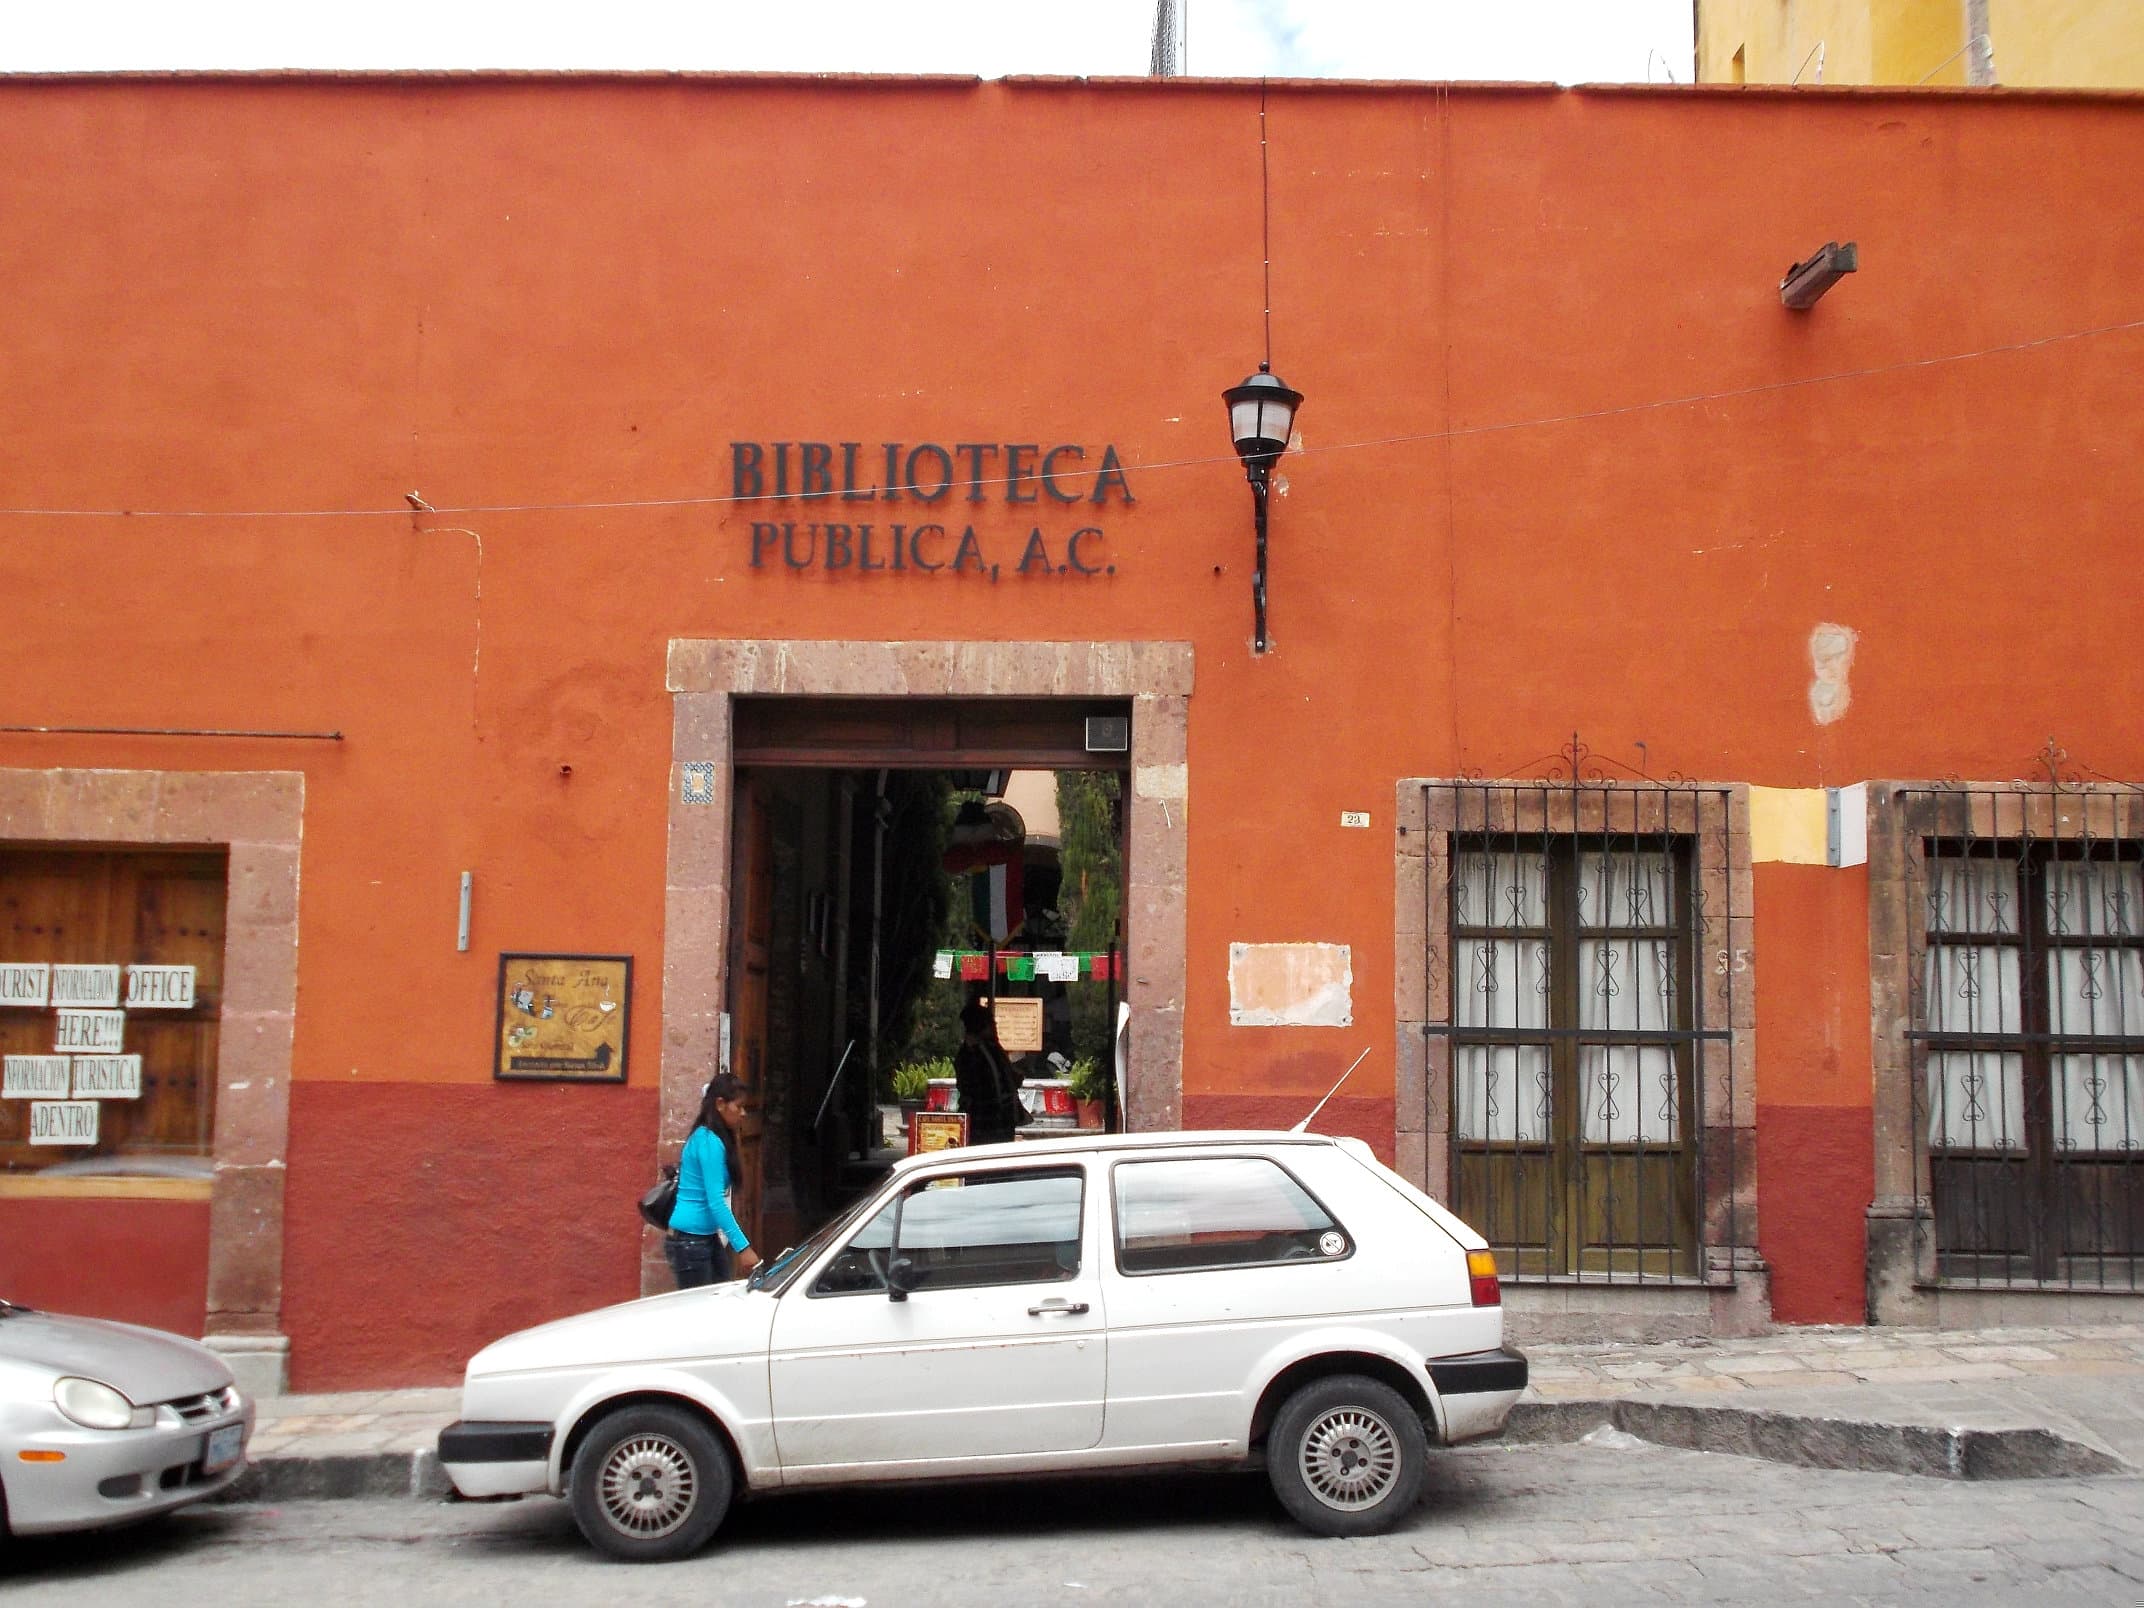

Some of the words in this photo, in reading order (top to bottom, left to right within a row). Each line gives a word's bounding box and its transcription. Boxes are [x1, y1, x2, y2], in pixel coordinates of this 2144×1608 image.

[729, 441, 1136, 505] BIBLIOTECA
[748, 521, 999, 584] PUBLICA,
[1015, 526, 1117, 575] A.C.
[0, 968, 46, 999] URIST
[54, 969, 115, 1001] NFORMATION
[128, 970, 191, 1002] OFFICE
[573, 969, 609, 988] Ana
[56, 1015, 121, 1046] HERE!!!
[6, 1059, 66, 1091] NFORMACION
[73, 1059, 137, 1091] TURISTICA
[31, 1105, 95, 1138] ADENTRO
